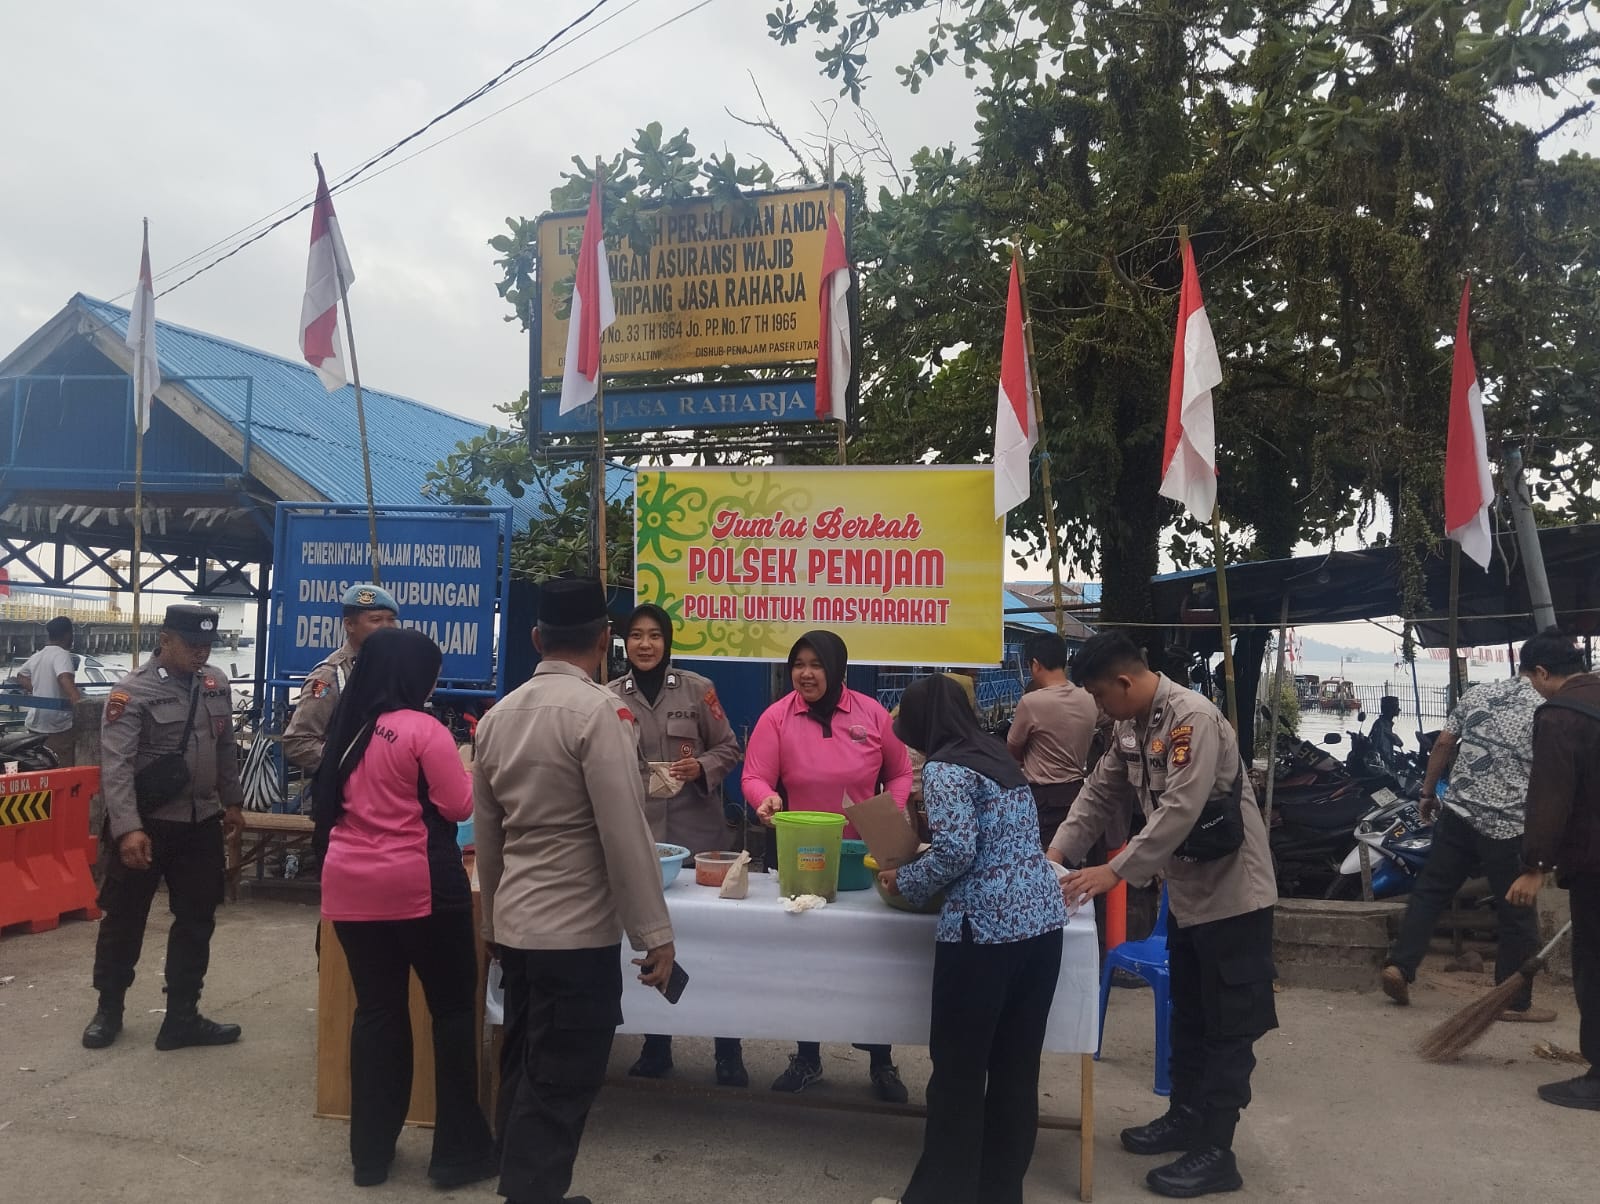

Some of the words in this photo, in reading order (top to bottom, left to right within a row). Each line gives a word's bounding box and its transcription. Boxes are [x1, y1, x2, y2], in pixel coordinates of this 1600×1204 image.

[780, 200, 828, 235] ANDA
[608, 253, 650, 283] NGAN
[656, 243, 738, 280] ASURANSI
[742, 238, 794, 272] WAJIB
[614, 282, 672, 317] UMPANG
[678, 278, 720, 312] JASA
[725, 272, 807, 308] RAHARJA
[626, 324, 640, 342] 33
[641, 321, 656, 341] TH
[656, 319, 682, 340] 1964
[686, 320, 703, 338] Jo.
[721, 317, 739, 336] No.
[740, 315, 752, 334] 17
[754, 314, 769, 333] TH
[772, 312, 797, 332] 1965
[609, 353, 629, 364] ASDP
[769, 341, 795, 353] PASER
[797, 340, 819, 352] UTAR
[606, 397, 667, 425] JASA
[679, 390, 807, 417] RAHARJA
[711, 508, 808, 541] Jum'at
[811, 506, 923, 541] Berkah
[301, 541, 363, 566] PEMERINTAH
[364, 542, 412, 568] PNAJAM
[413, 543, 446, 568] PASER
[448, 545, 481, 569] UTARA
[687, 546, 798, 585] POLSEK
[806, 548, 946, 596] PENAJAM
[299, 579, 348, 603] DINAS
[354, 580, 480, 607] HUBUNGAN
[683, 594, 739, 621] POLRI
[743, 594, 806, 622] UNTUK
[811, 597, 951, 625] MASYARAKAT
[295, 615, 346, 649] DERM
[396, 618, 478, 656] NAJAM
[374, 724, 399, 744] KARI
